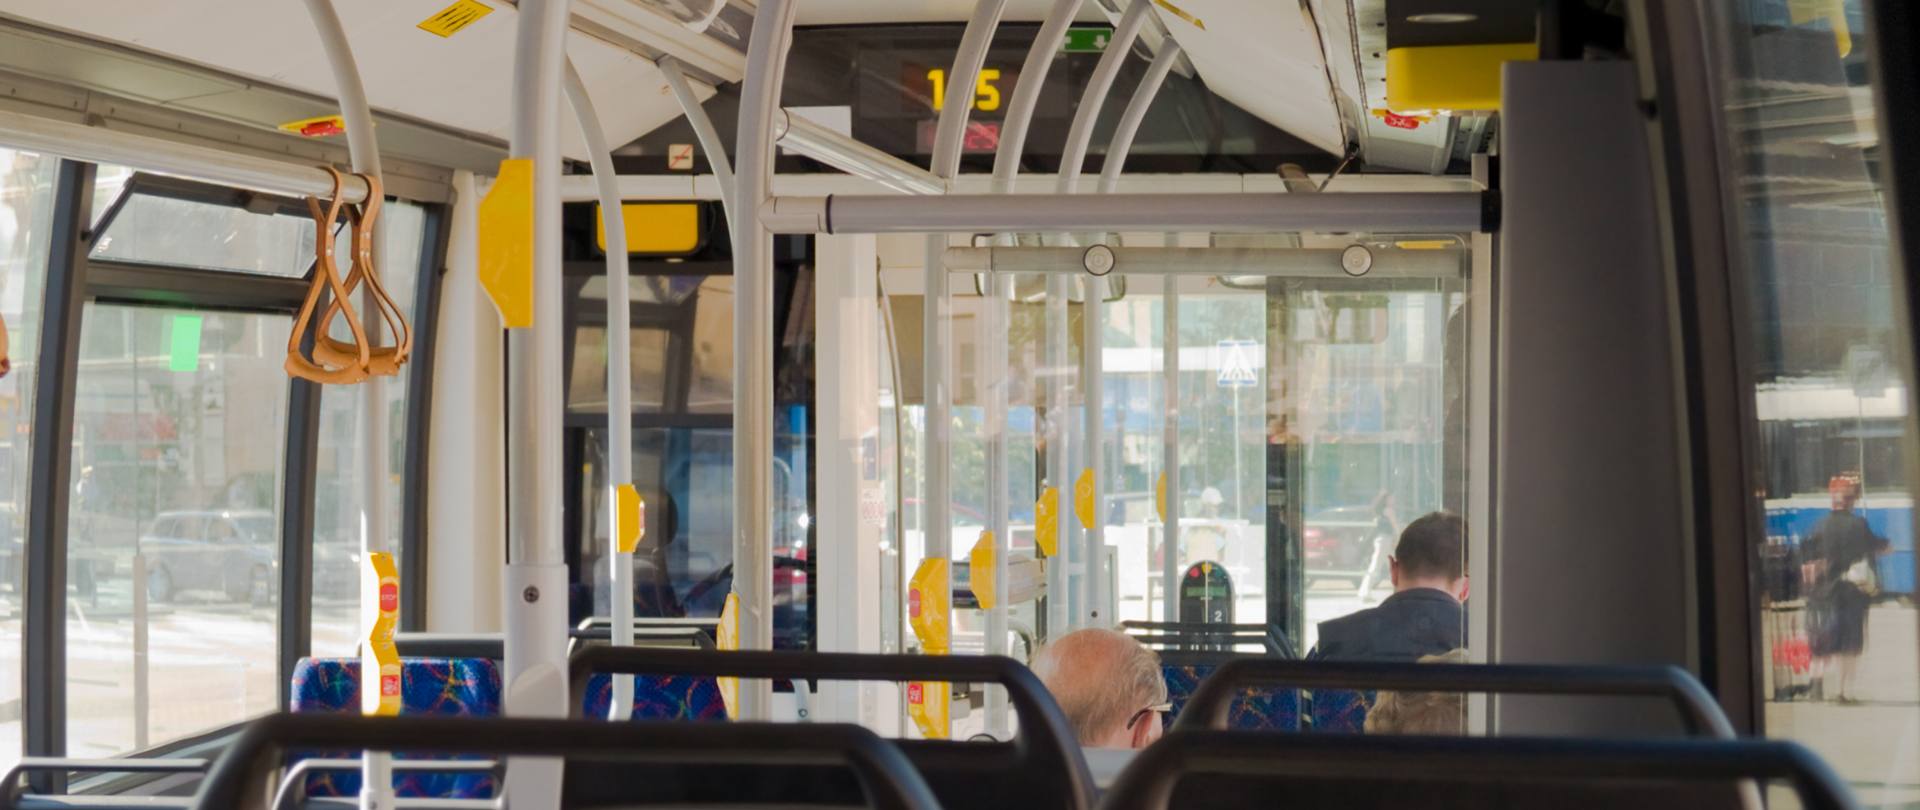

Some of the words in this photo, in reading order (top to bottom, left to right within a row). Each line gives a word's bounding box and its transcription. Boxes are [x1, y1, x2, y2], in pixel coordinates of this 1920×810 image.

[927, 69, 1000, 111] 15
[381, 593, 397, 602] STOP
[1214, 610, 1223, 622] 2
